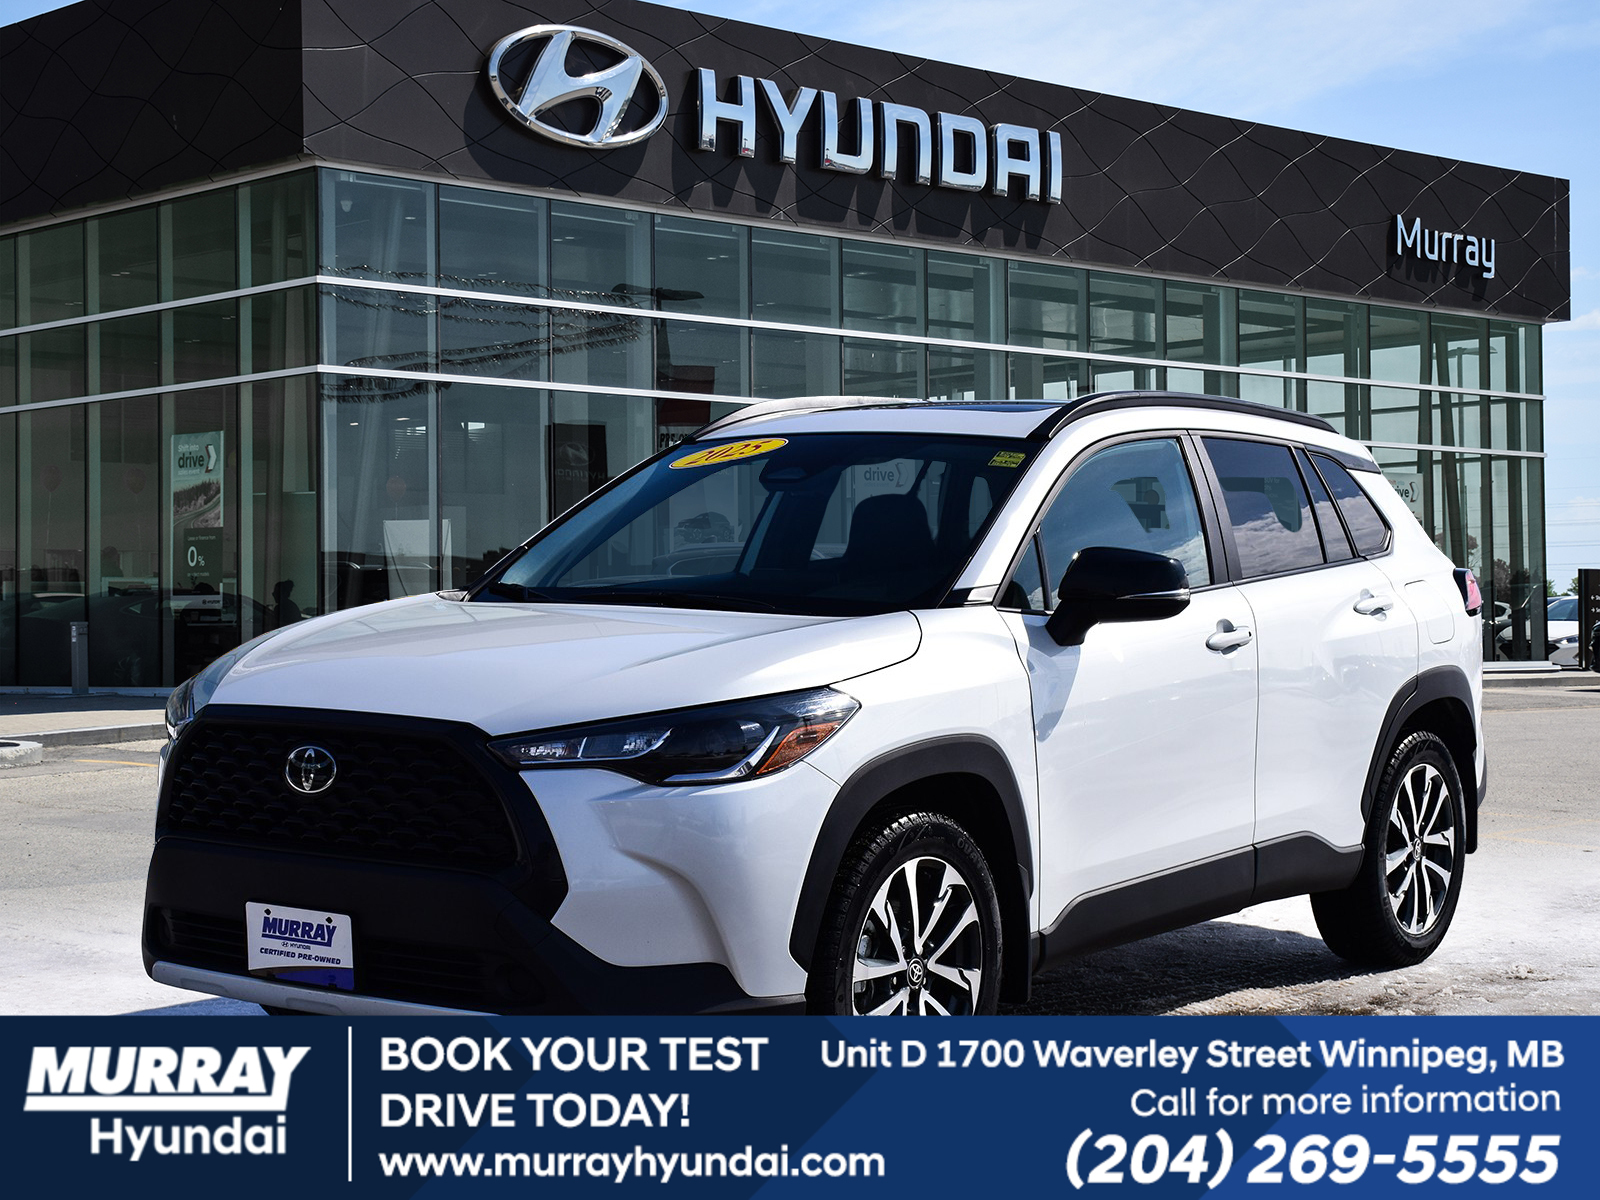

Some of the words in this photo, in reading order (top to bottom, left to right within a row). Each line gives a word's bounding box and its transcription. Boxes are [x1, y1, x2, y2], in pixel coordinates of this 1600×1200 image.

[697, 67, 1062, 205] HYUNDAI
[1396, 213, 1495, 279] Murray
[178, 452, 205, 469] drive
[684, 439, 773, 466] 2025
[863, 467, 895, 482] drive
[261, 916, 337, 947] MURRAY
[259, 947, 296, 958] CERTIFIED
[297, 952, 341, 965] PRE-OWNED
